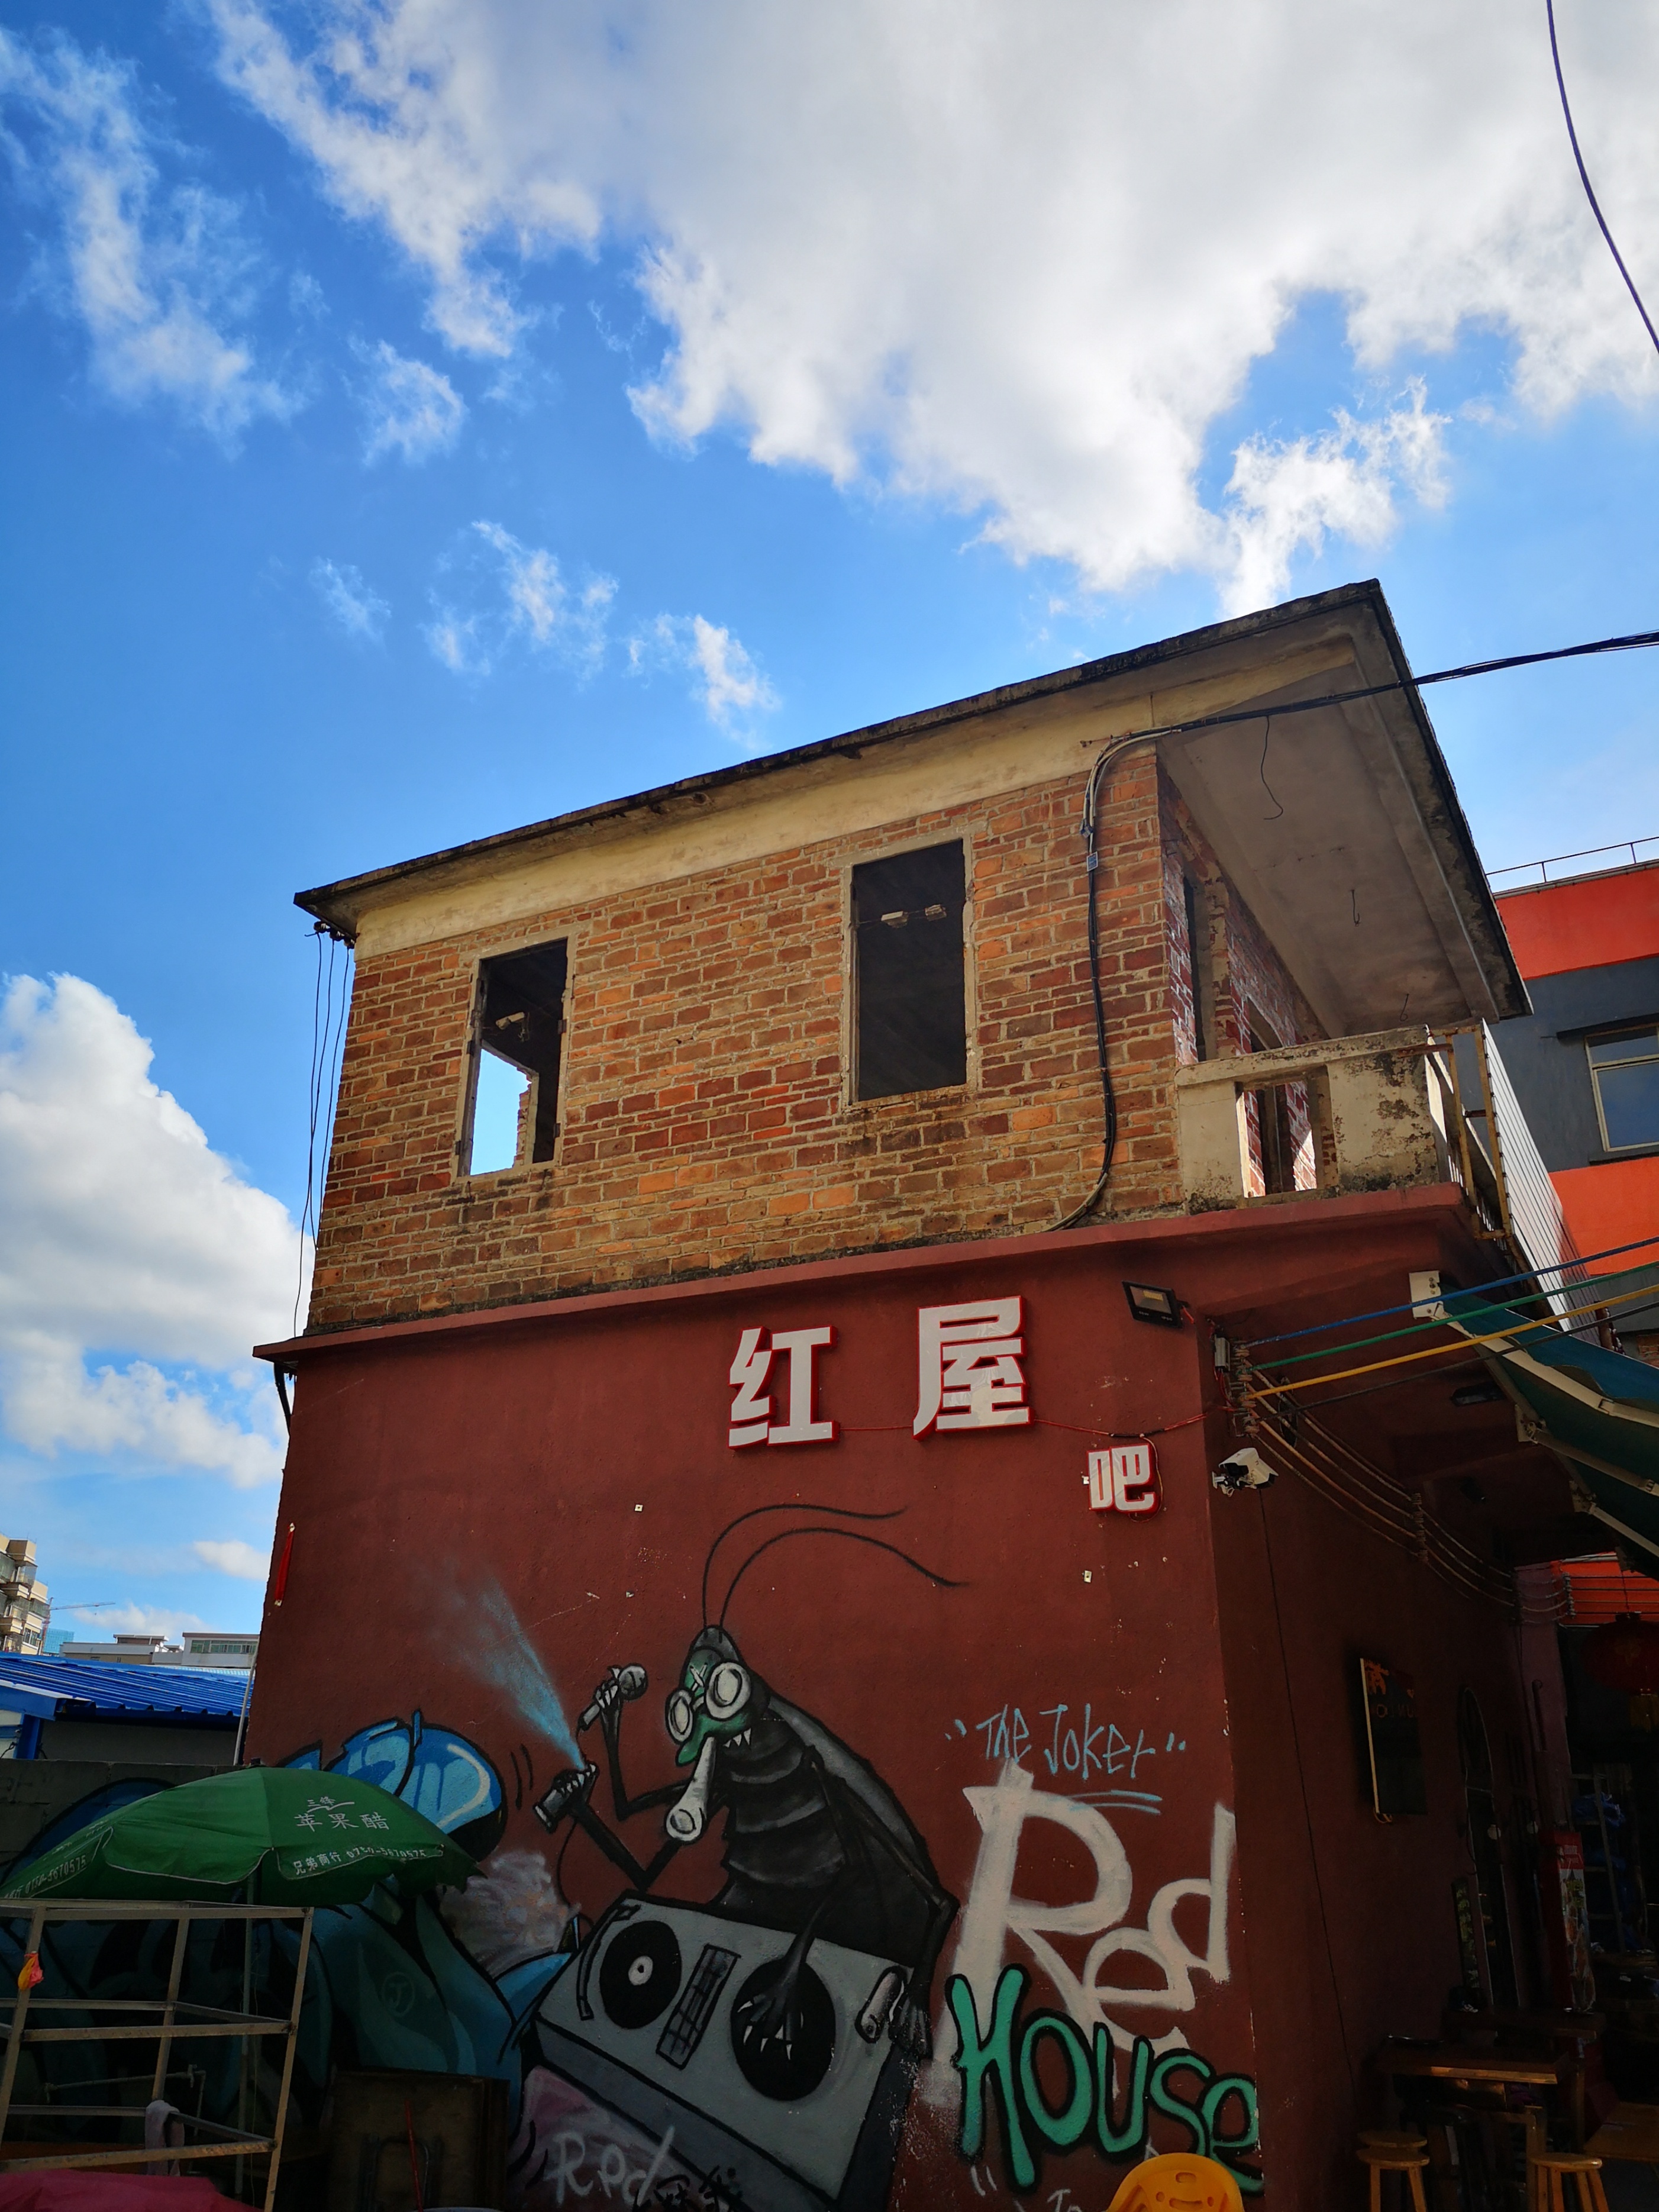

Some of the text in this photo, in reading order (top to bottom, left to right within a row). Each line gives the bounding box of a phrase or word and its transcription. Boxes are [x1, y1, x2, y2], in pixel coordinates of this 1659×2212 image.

[727, 1295, 1034, 1449] 红屋
[1086, 1444, 1160, 1515] 吧
[294, 1811, 389, 1832] 苹果醋
[293, 1851, 343, 1876] 兄弟商行
[925, 1760, 1235, 2103] Red
